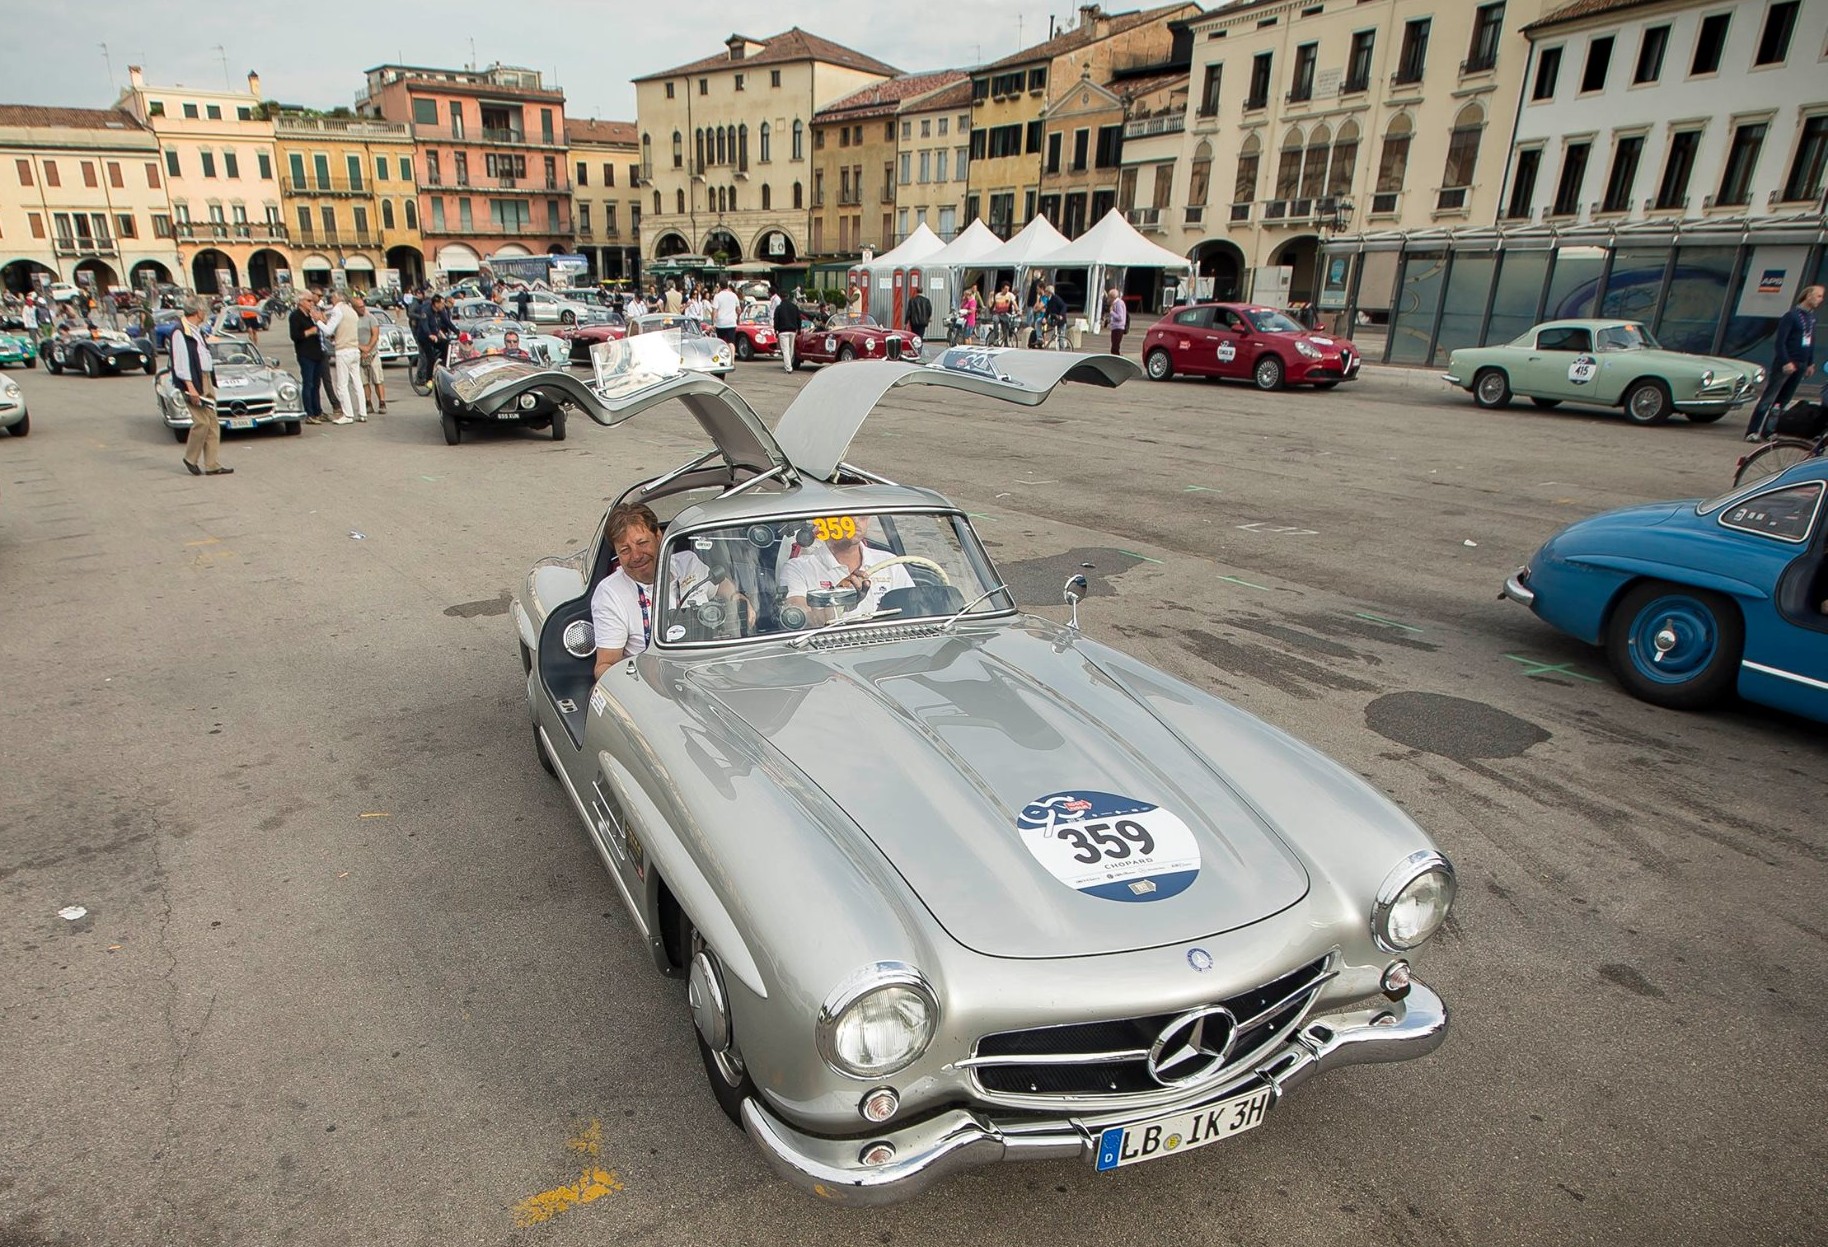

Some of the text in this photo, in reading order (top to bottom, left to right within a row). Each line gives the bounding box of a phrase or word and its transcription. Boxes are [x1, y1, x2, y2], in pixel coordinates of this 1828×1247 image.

[1761, 277, 1783, 286] APS
[1574, 366, 1590, 376] 415
[813, 515, 857, 541] 359
[1057, 819, 1155, 865] 359
[1104, 857, 1154, 870] CHOPARD
[1120, 1093, 1267, 1161] LB IK 3H
[1104, 1152, 1113, 1164] D
